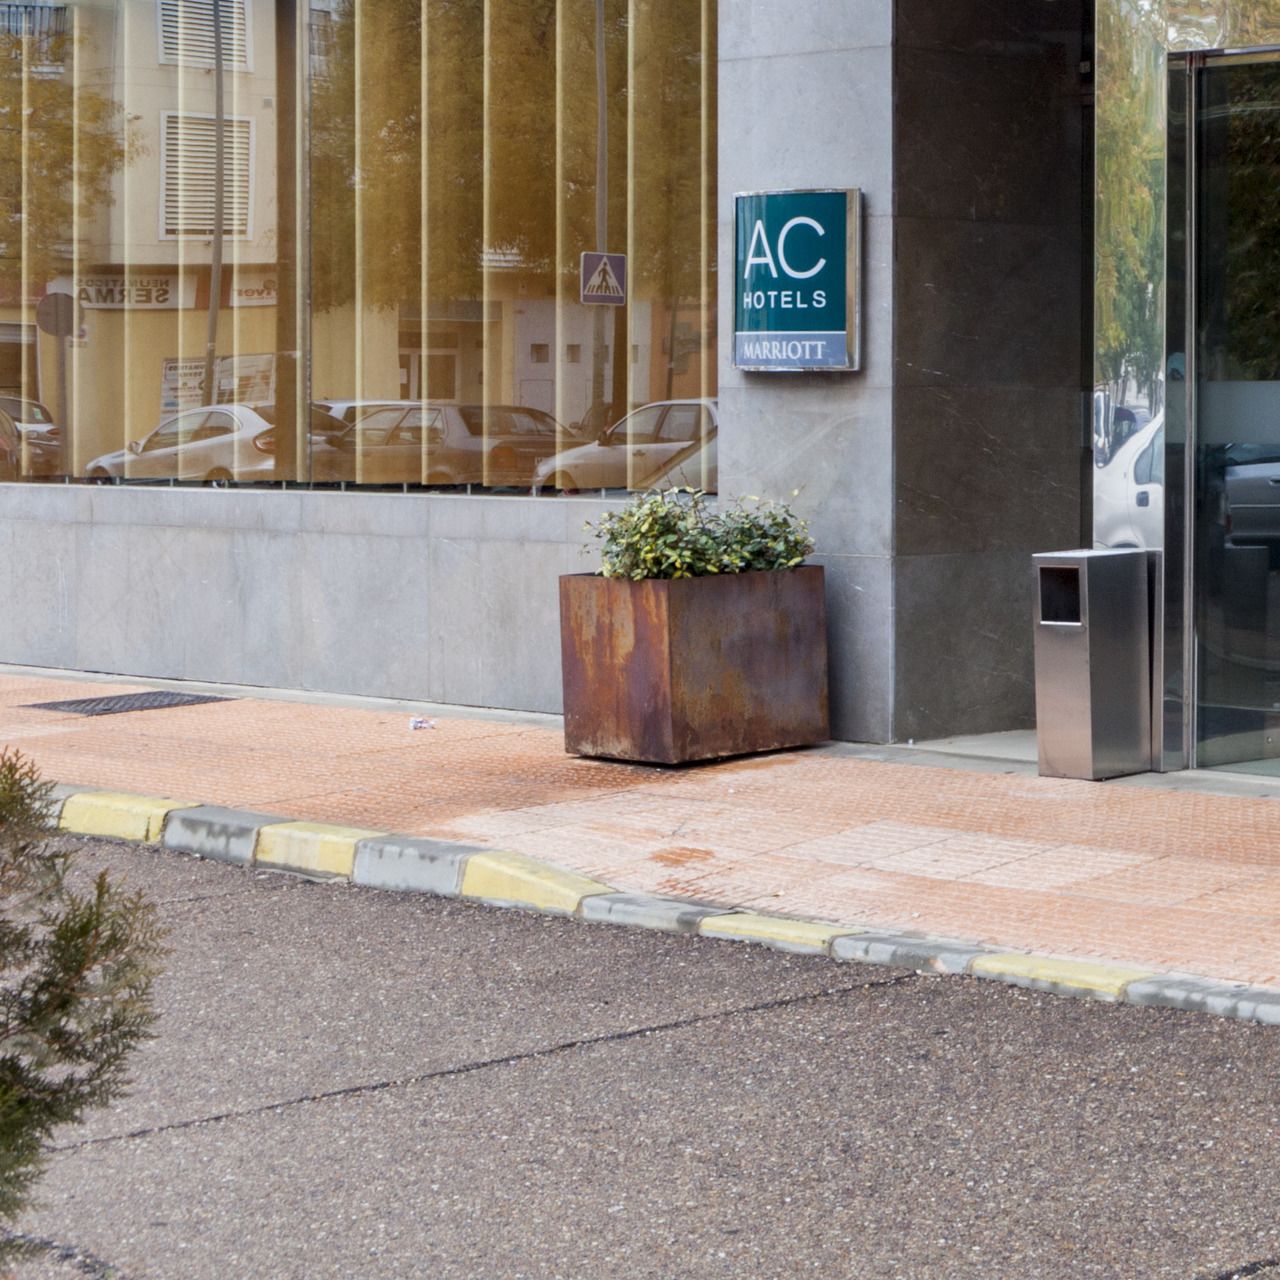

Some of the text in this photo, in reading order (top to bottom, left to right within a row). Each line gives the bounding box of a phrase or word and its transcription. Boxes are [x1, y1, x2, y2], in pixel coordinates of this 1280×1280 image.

[744, 216, 826, 279] AC
[743, 290, 827, 309] HOTELS
[743, 341, 827, 360] MARRIOTT
